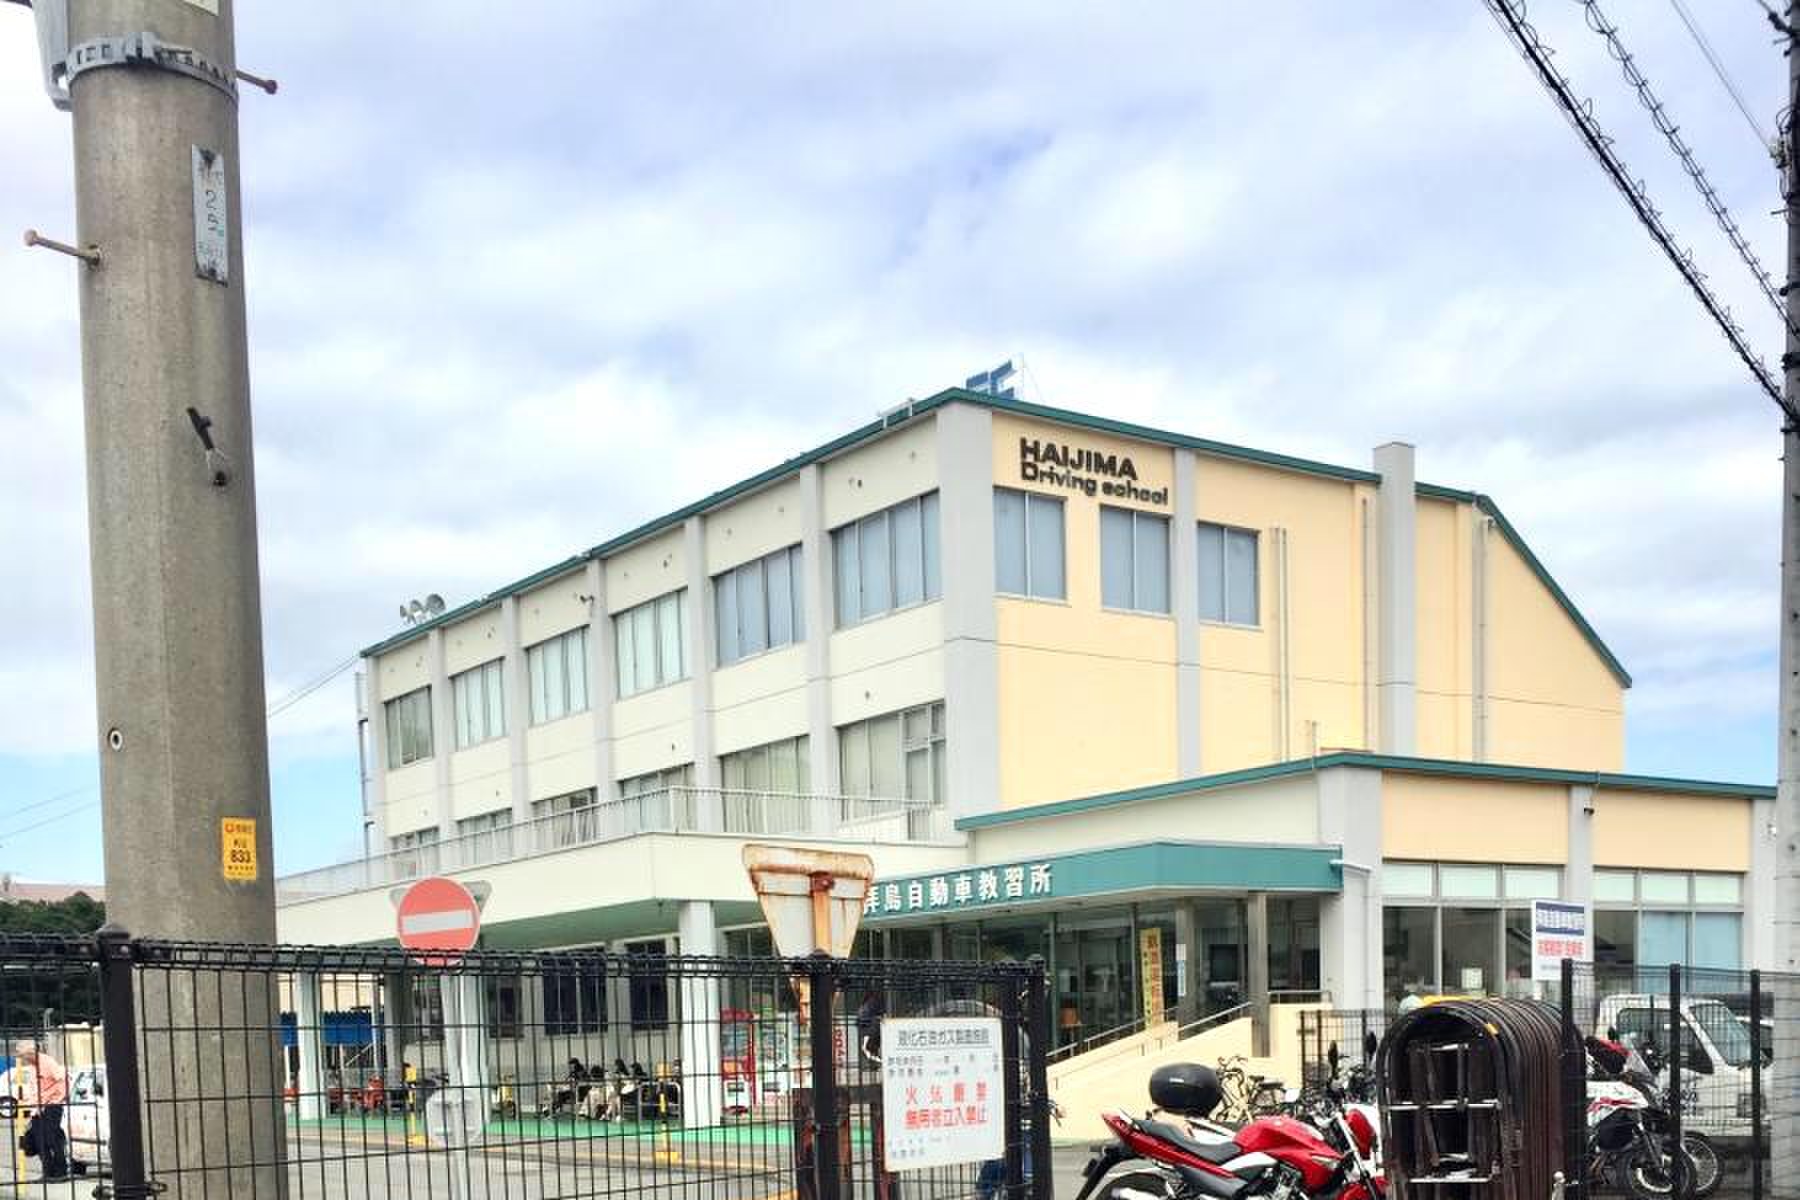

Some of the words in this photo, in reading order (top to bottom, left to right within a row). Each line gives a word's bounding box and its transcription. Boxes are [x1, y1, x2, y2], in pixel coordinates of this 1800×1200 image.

[1019, 437, 1138, 480] HAIJIMA
[1020, 461, 1098, 497] Driving
[1101, 479, 1169, 506] school
[230, 849, 251, 863] 833
